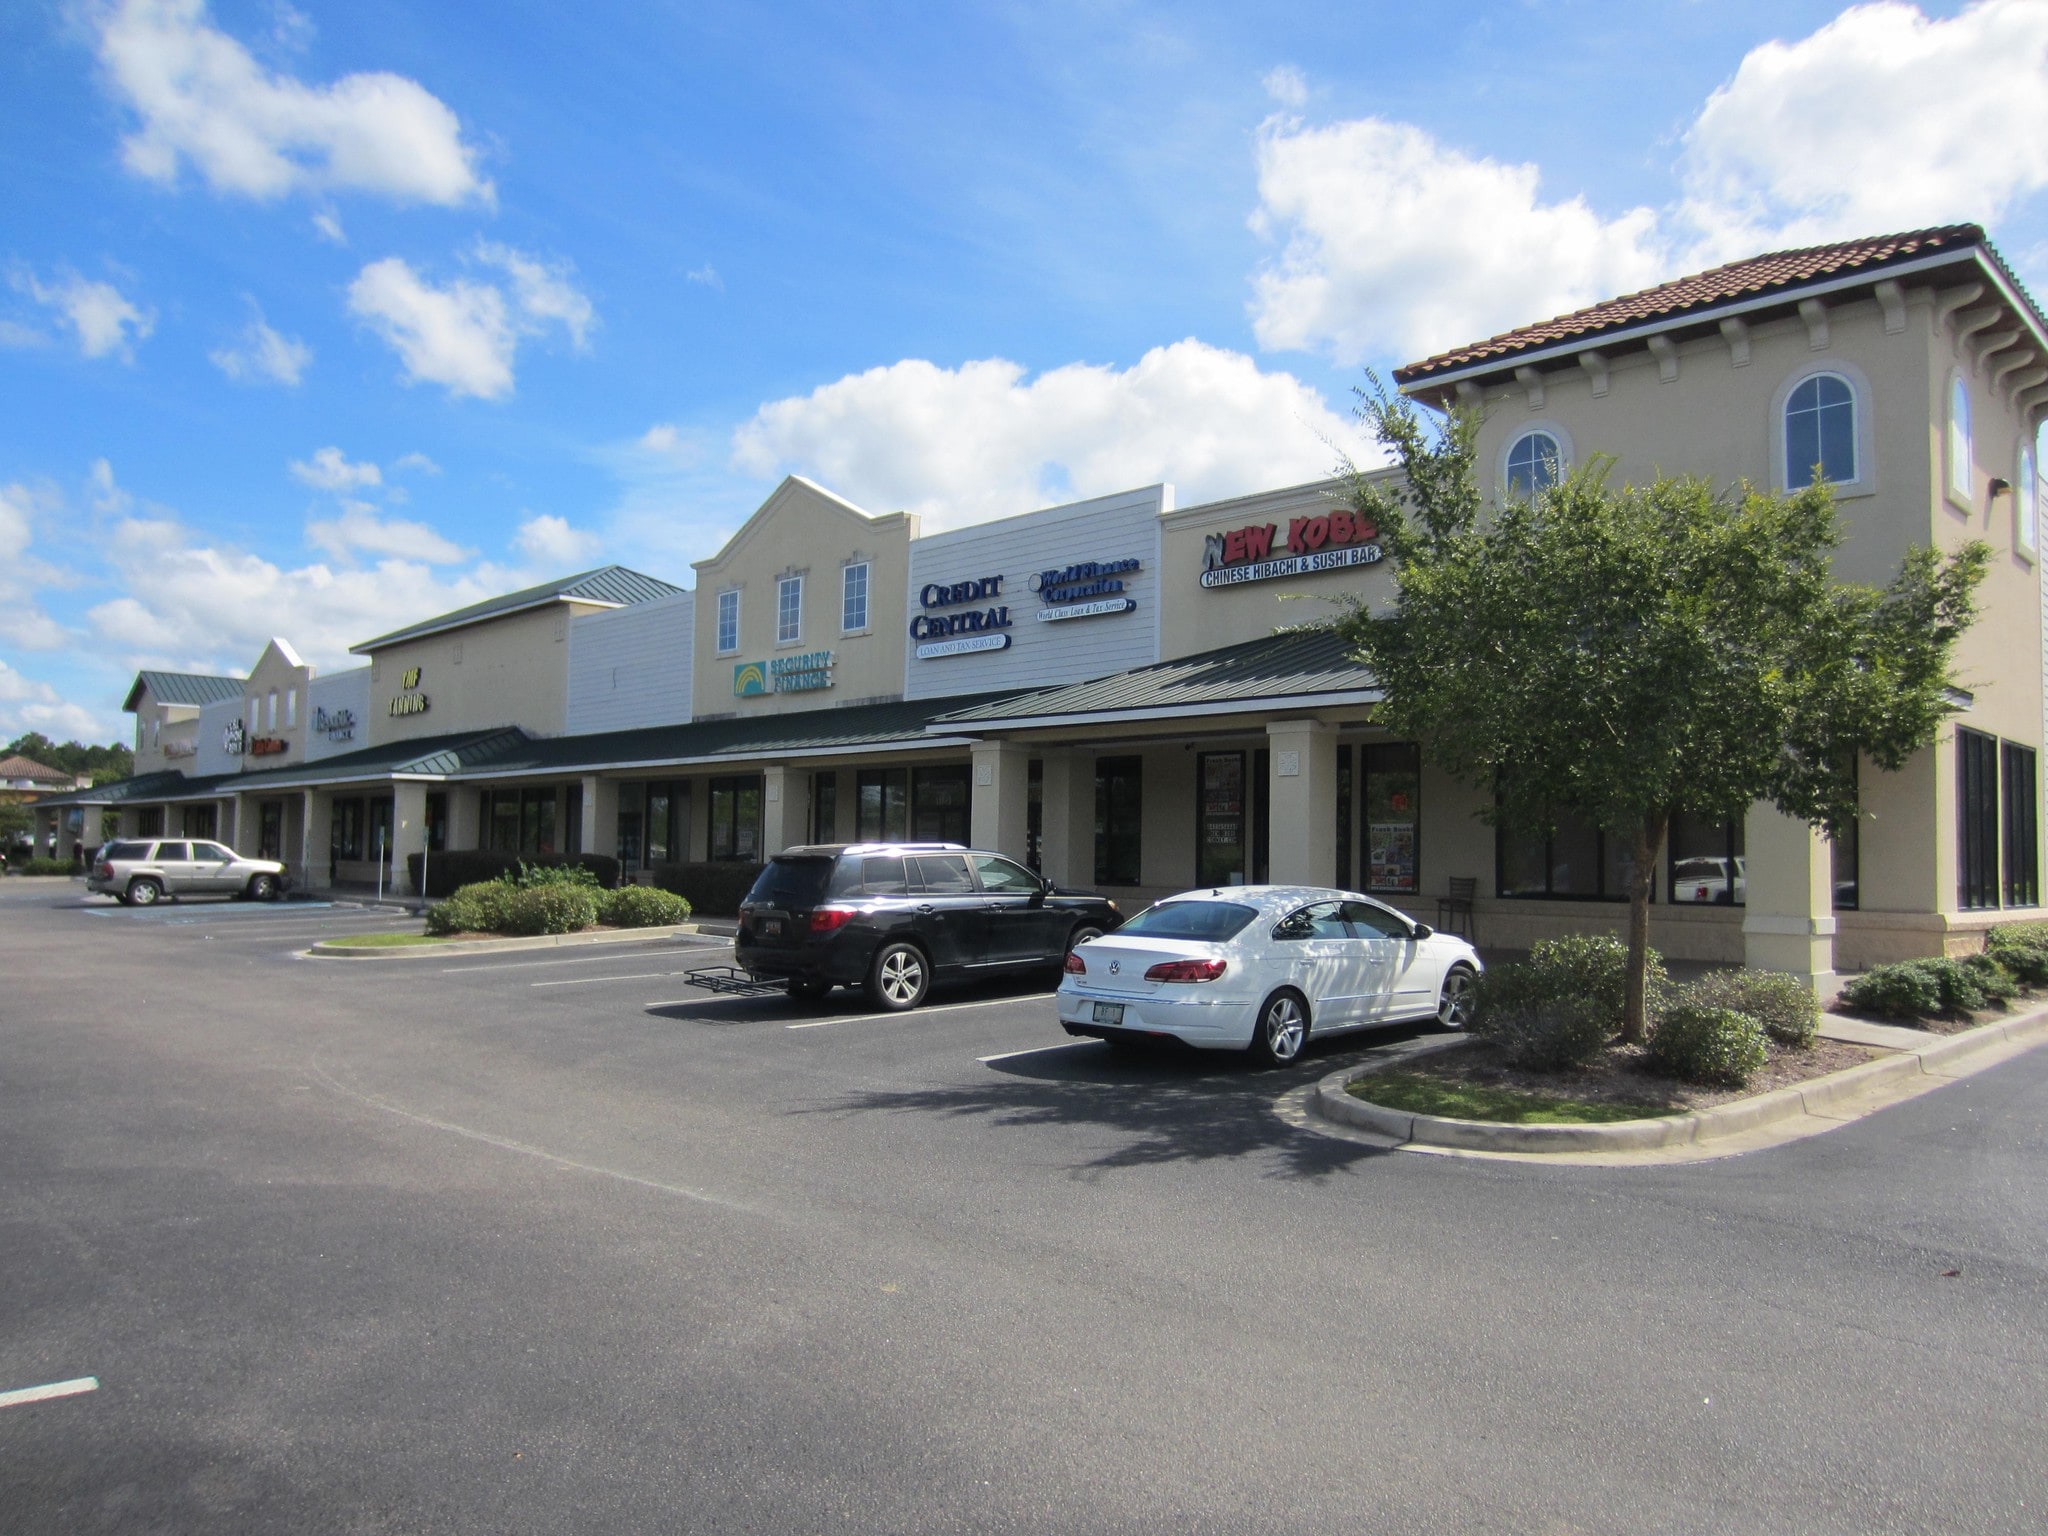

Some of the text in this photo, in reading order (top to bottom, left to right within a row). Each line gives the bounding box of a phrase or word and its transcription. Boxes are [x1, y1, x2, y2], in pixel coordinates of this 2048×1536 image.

[1202, 523, 1278, 570] NEW
[1206, 546, 1376, 586] CHINESE HIBACHI & SUSHI BAR
[920, 574, 1004, 609] CREDIT
[910, 605, 1013, 640] CENTRAL
[1039, 599, 1126, 620] World Class Loan & Tax Service
[920, 637, 1002, 657] LOAN AND TAX SERVICE
[770, 650, 832, 676] SECURITY
[774, 670, 830, 694] FINANCE
[389, 693, 426, 717] TANNING
